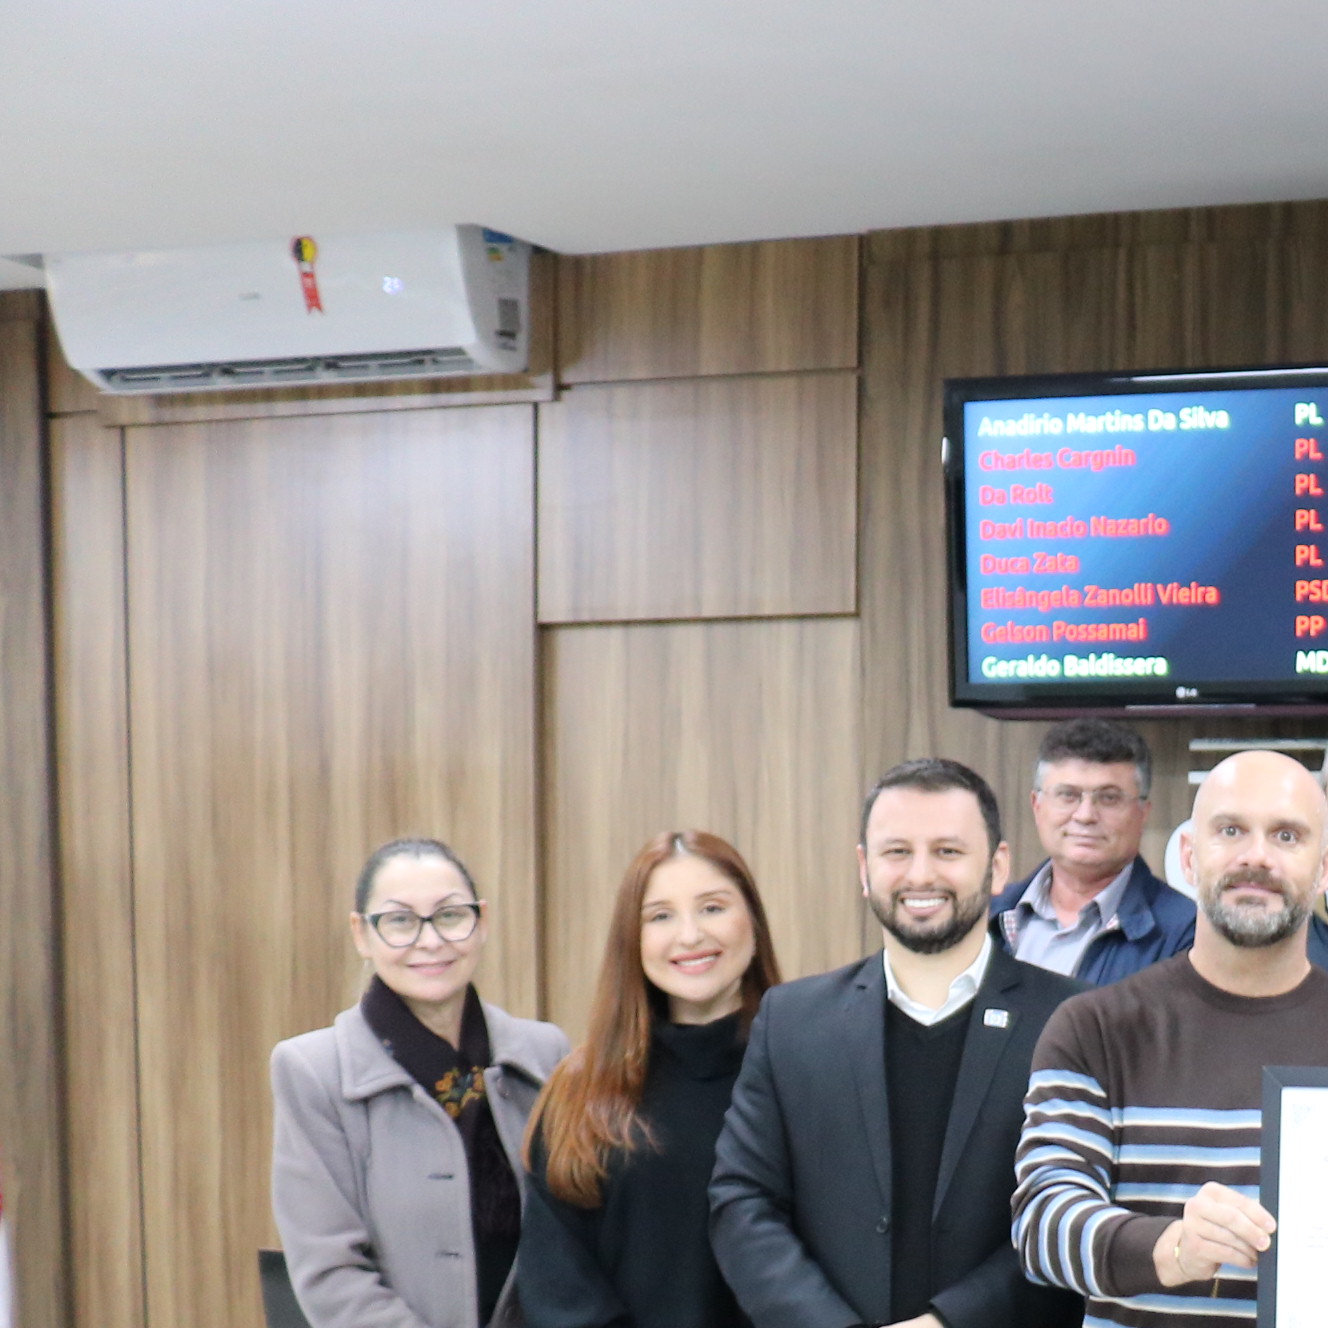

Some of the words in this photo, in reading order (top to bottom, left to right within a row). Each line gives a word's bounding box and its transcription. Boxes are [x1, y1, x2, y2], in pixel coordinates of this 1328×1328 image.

[1066, 410, 1144, 434] Martins
[1148, 409, 1176, 431] Da
[1179, 406, 1229, 429] Silva
[1295, 402, 1324, 425] PL
[979, 449, 1053, 471] Charles
[1057, 445, 1136, 471] Cargnin
[1295, 438, 1325, 460] PL
[979, 485, 1006, 505] Da
[1010, 482, 1053, 504] Rolt
[1295, 473, 1325, 496] PL
[980, 518, 1023, 540] Davi
[1295, 509, 1325, 532] PL
[980, 554, 1030, 575] Duca
[1295, 545, 1325, 567] PL
[1084, 582, 1154, 607] Zanolli
[1158, 582, 1220, 605] Vieira
[981, 620, 1050, 643] Gelson
[1053, 618, 1147, 642] Possamai
[1295, 615, 1327, 637] PP
[981, 654, 1061, 678] Geraldo
[1063, 653, 1168, 677] Baldissera
